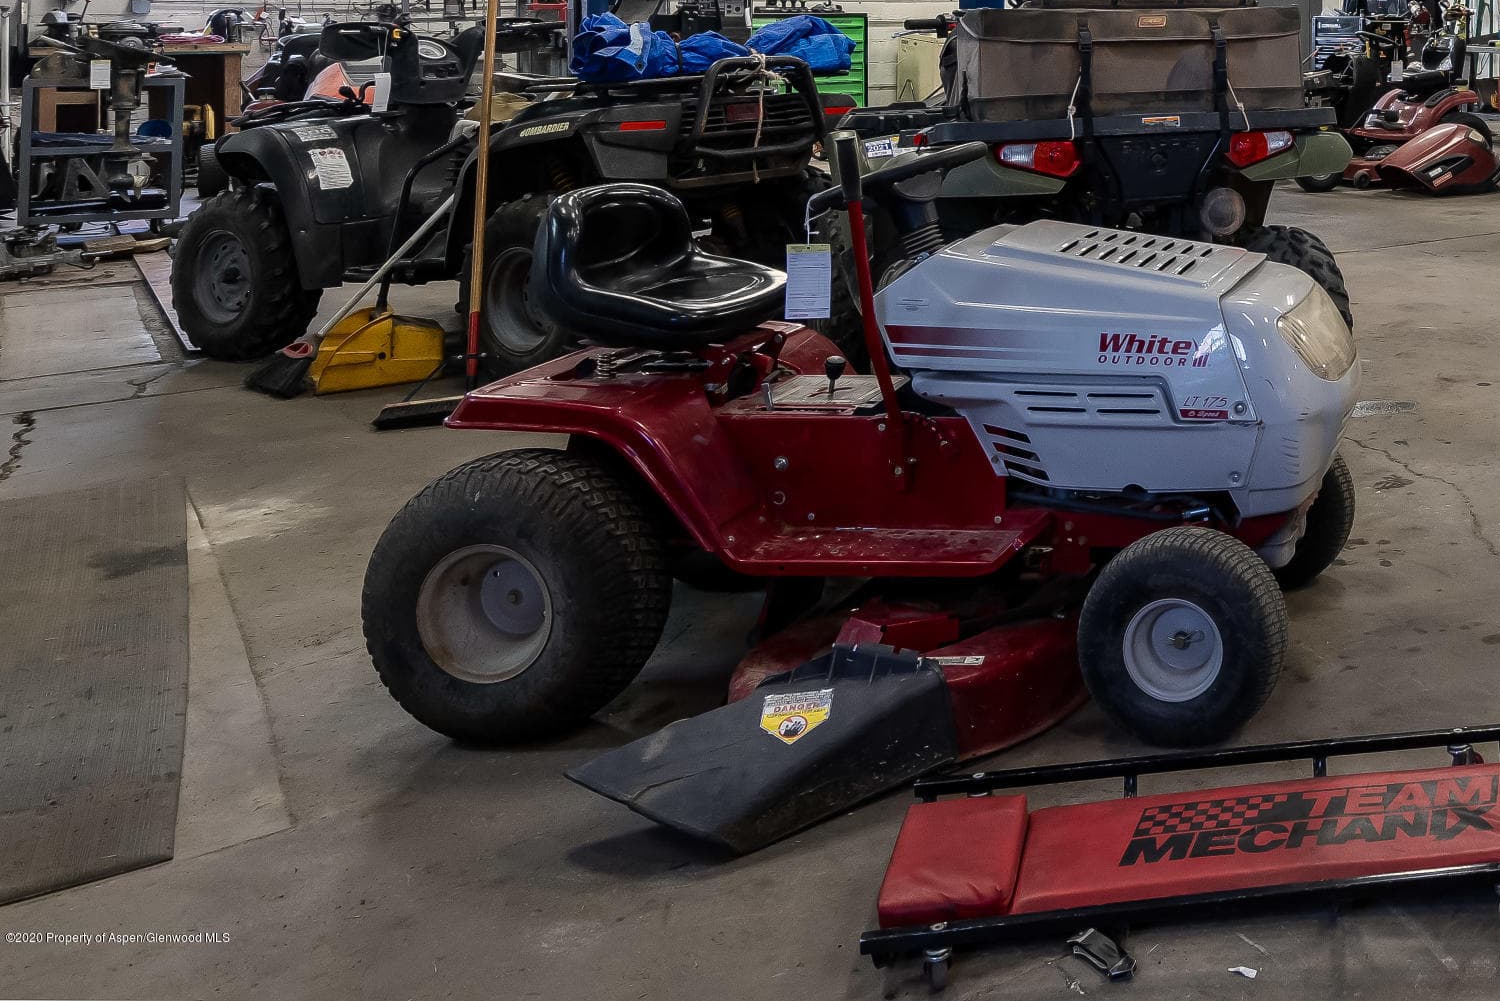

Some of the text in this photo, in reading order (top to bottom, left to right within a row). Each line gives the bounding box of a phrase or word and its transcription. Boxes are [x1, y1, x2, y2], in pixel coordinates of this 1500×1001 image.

[520, 122, 569, 137] BOMBARDIER
[1099, 332, 1192, 356] White
[1098, 354, 1187, 367] OUTDOOR
[1183, 396, 1228, 408] LT 175
[773, 702, 820, 713] DANGER
[1302, 775, 1497, 817] TEAM
[1119, 804, 1498, 867] MECHANIX
